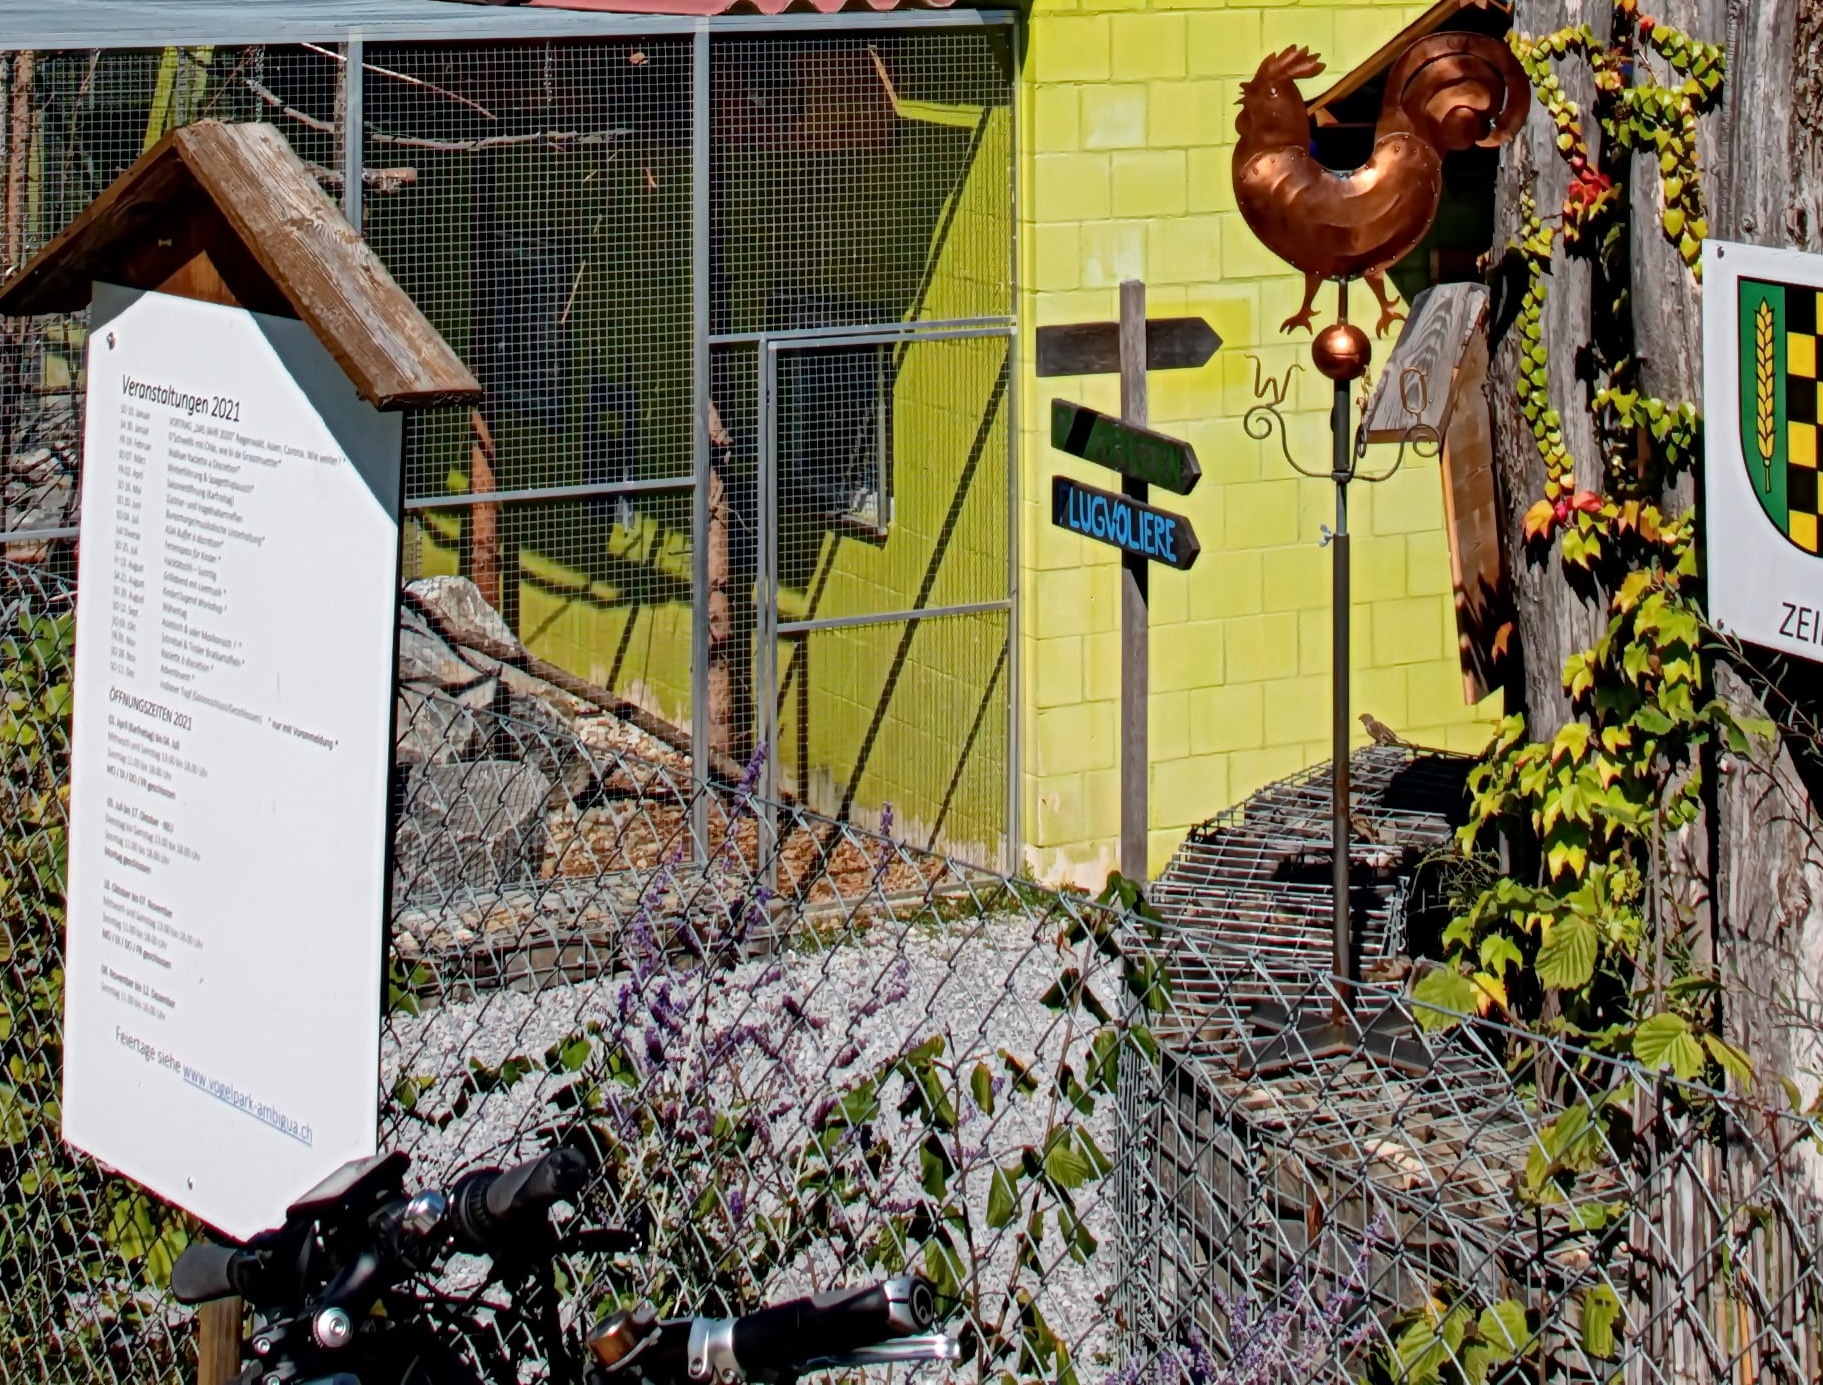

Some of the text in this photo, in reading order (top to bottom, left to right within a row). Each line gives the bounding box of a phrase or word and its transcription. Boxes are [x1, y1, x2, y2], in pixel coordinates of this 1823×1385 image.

[122, 373, 241, 422] Veranstaltungen 2021
[109, 686, 172, 722] ÖFFNUNGSZEITEN
[173, 712, 192, 731] 2021
